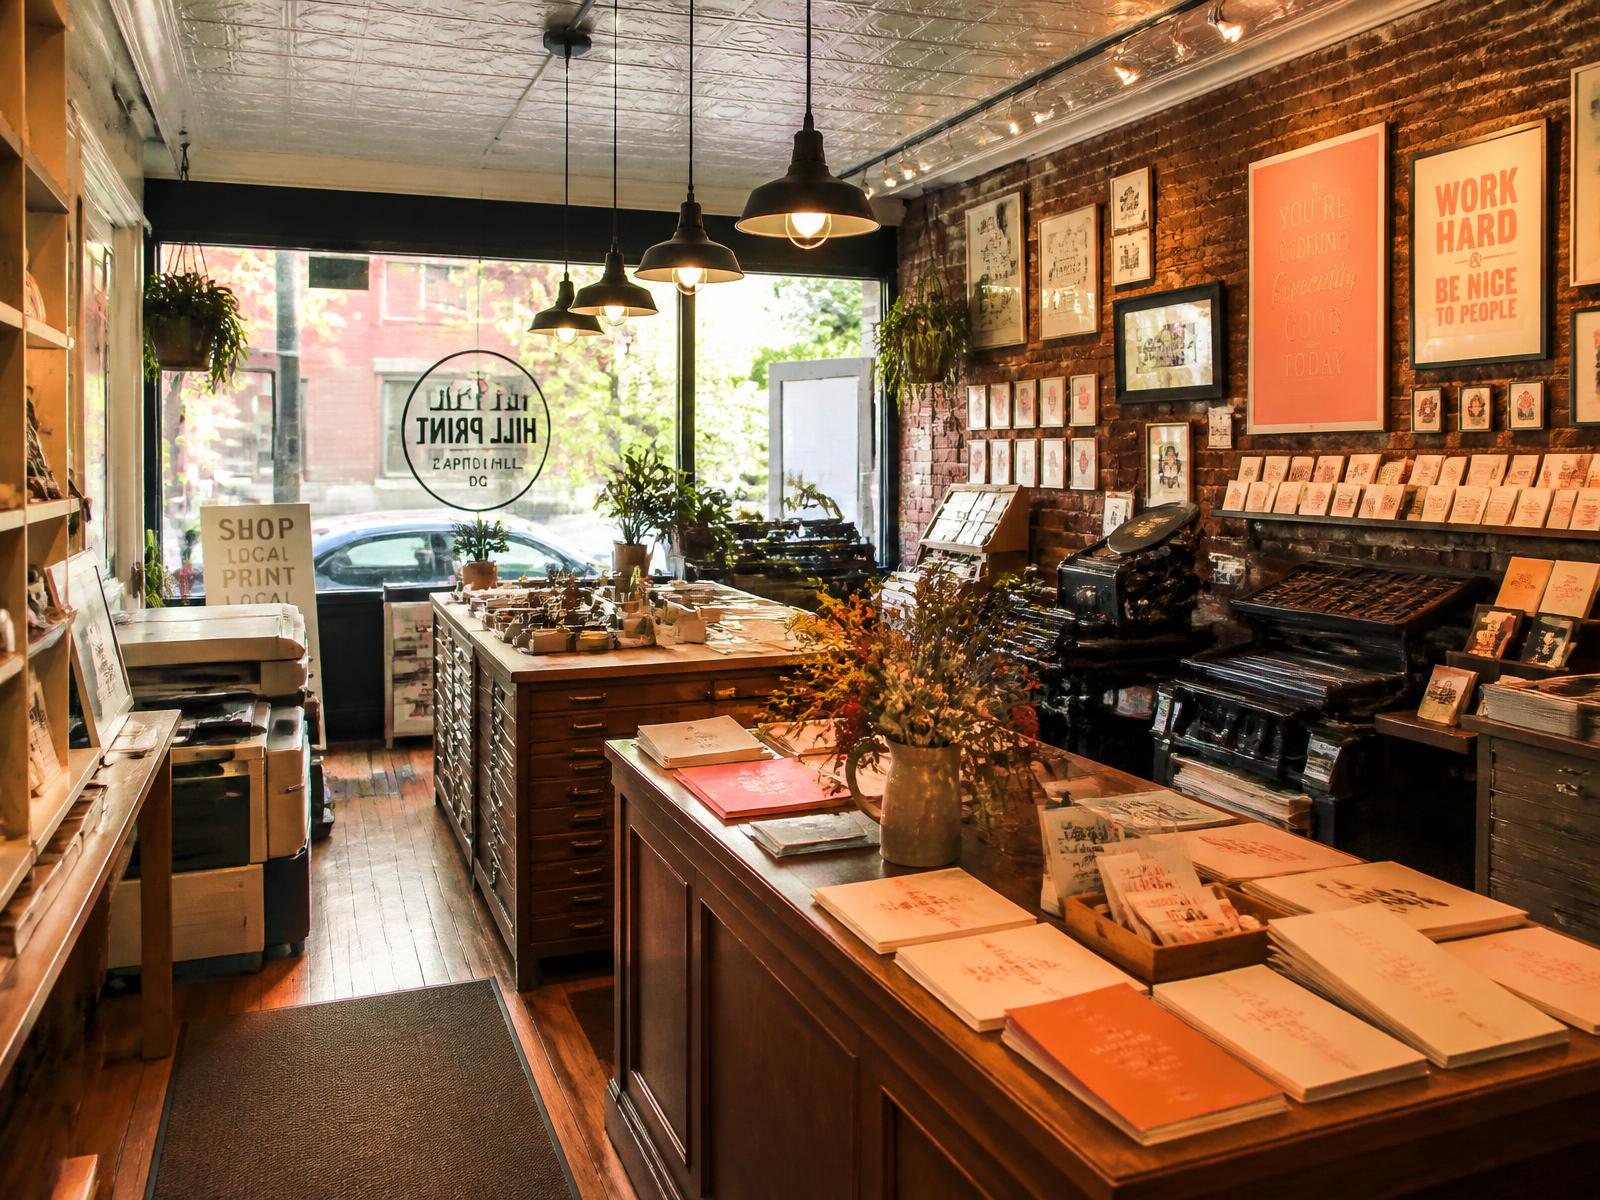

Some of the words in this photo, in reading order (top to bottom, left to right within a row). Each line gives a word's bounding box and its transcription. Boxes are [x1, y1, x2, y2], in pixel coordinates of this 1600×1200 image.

[1435, 167, 1518, 218] WORK
[1436, 208, 1517, 255] HARD
[1436, 275, 1460, 304] BE
[1467, 267, 1517, 301] NICE
[1435, 305, 1455, 327] TO
[1460, 298, 1517, 324] PEOPLE
[1280, 351, 1345, 377] TODAY
[219, 518, 294, 541] SHOP
[227, 546, 289, 564] LOCAL
[222, 567, 295, 588] PRINT
